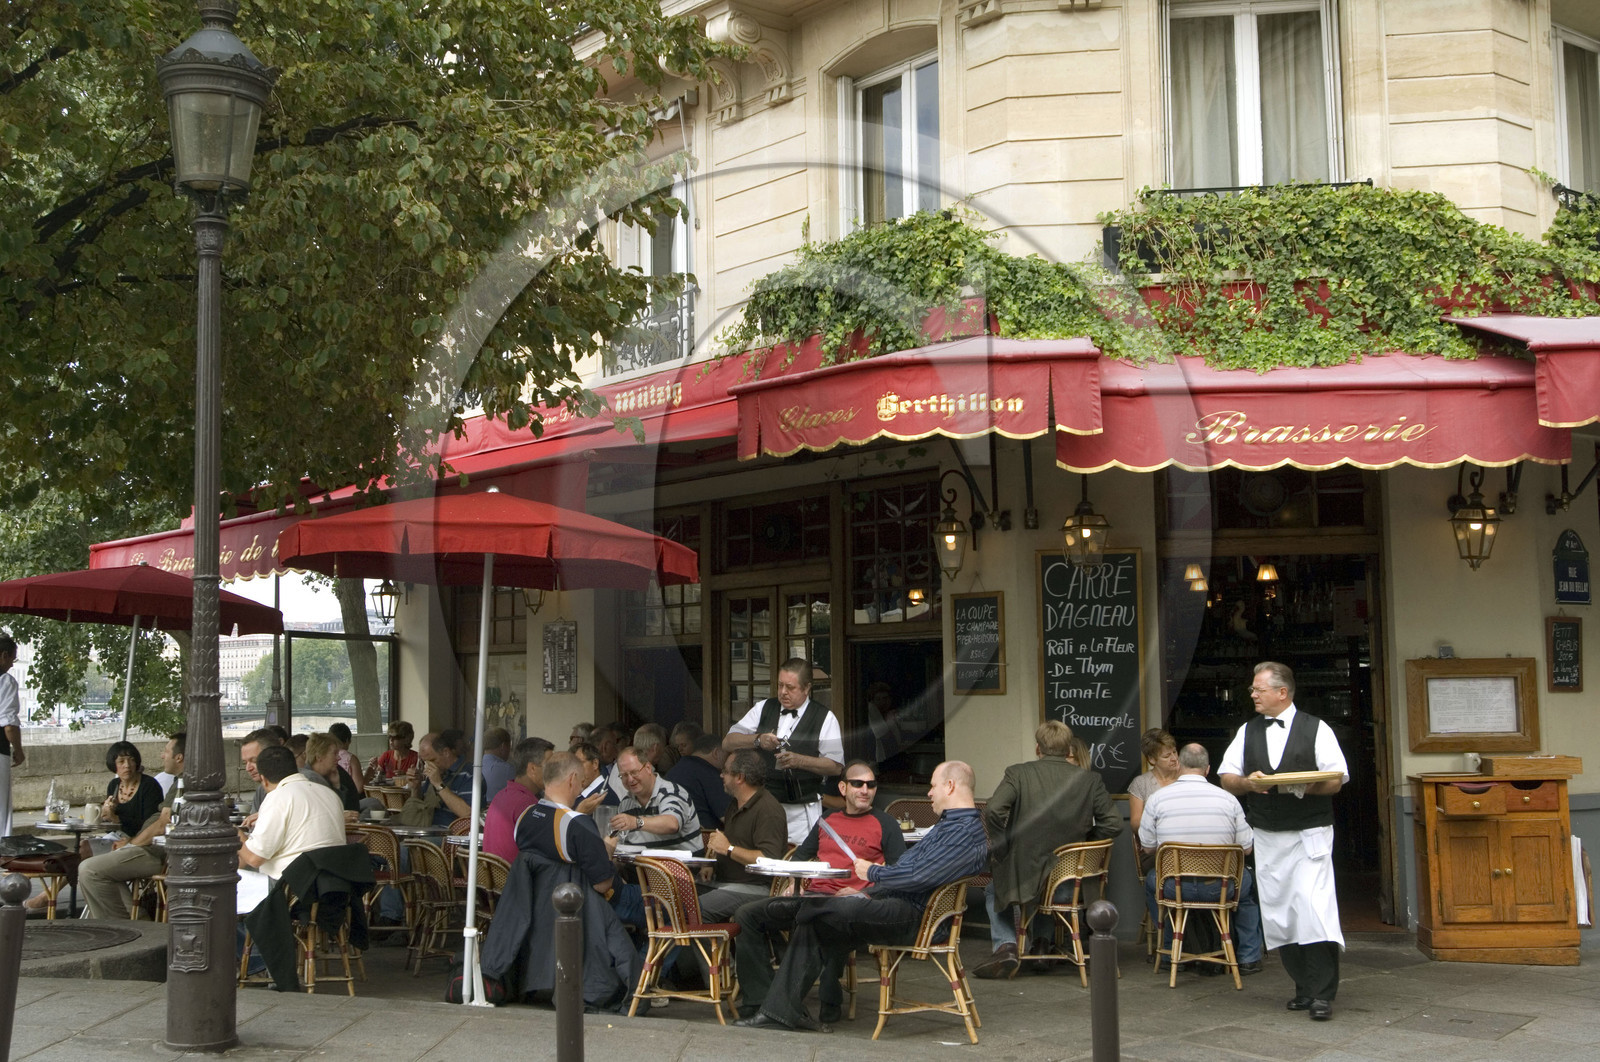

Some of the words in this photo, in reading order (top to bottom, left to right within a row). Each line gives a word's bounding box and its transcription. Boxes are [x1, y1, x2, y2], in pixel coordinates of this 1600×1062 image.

[778, 405, 861, 432] Glaces
[876, 391, 1024, 421] Berthillon
[1185, 411, 1438, 444] Brasserie
[158, 545, 236, 572] Brasie
[240, 534, 267, 562] de
[1045, 556, 1133, 599] CARRÉ
[956, 608, 966, 620] LA
[967, 604, 996, 620] COUPE
[1045, 602, 1135, 631] D'AGNEAU
[1075, 657, 1113, 676] Thym
